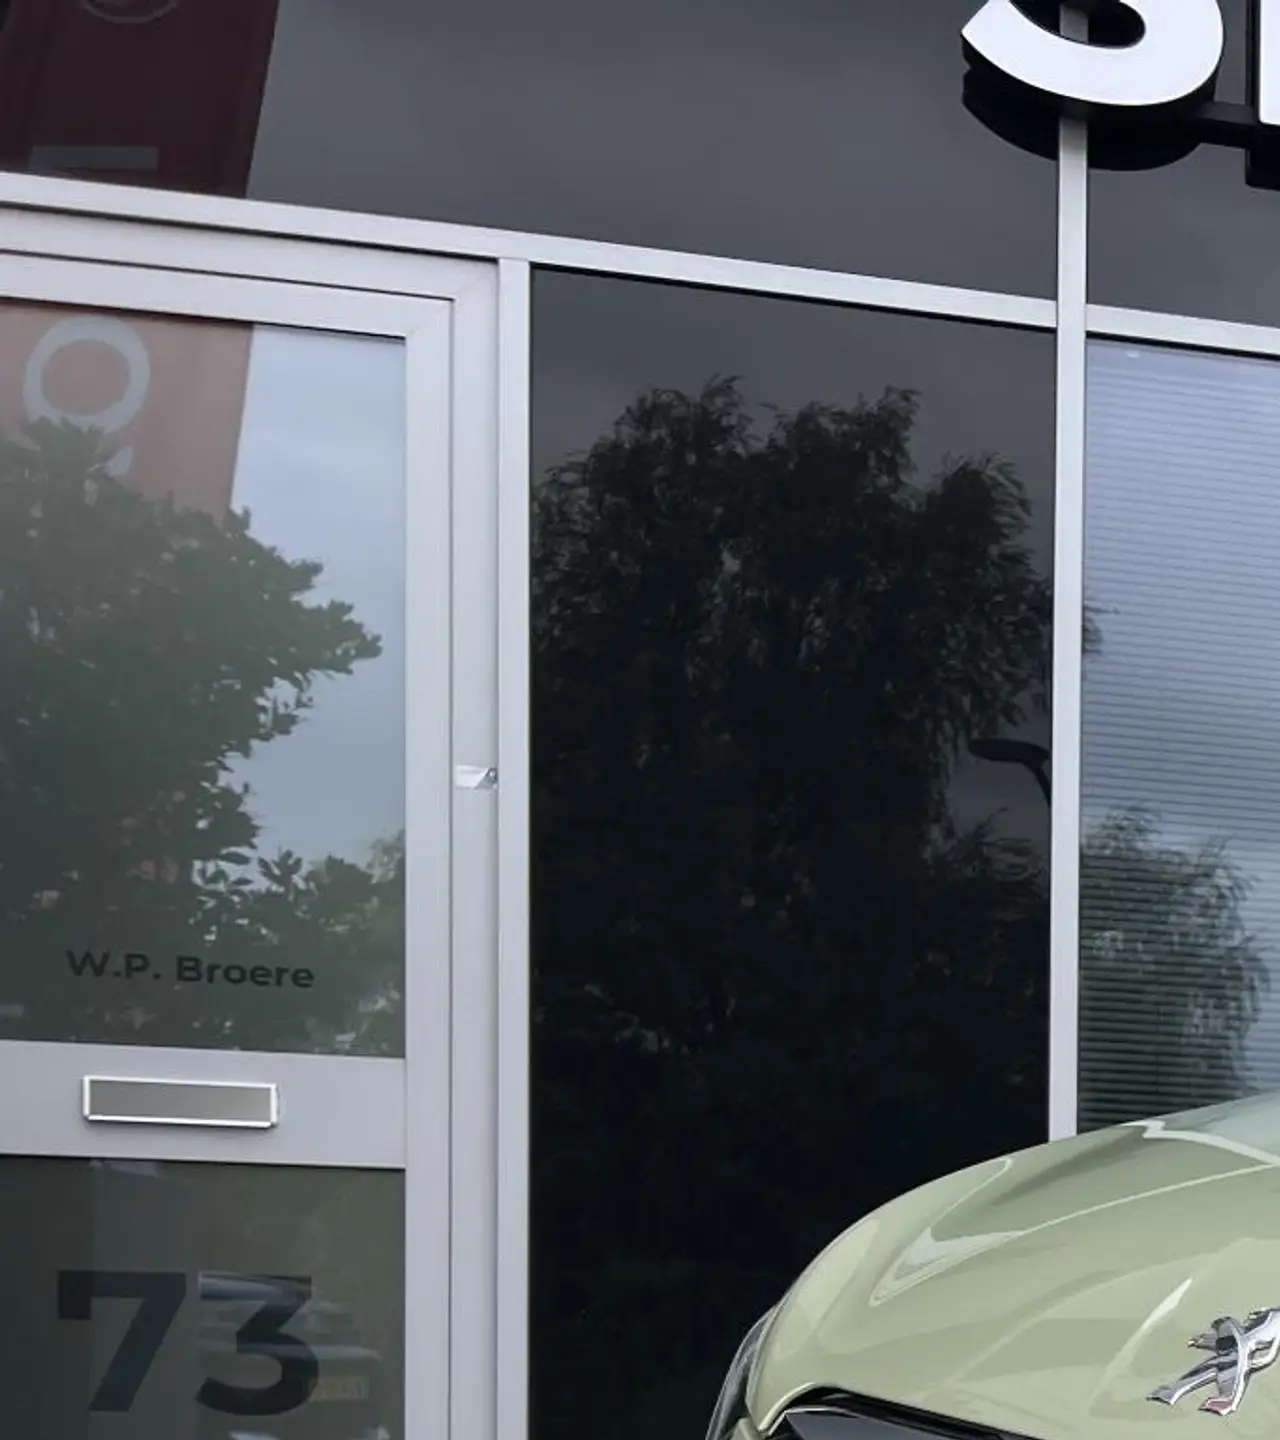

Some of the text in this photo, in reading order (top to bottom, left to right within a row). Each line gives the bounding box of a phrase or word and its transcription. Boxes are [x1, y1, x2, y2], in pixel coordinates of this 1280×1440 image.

[66, 949, 315, 988] W.P. Broere
[57, 1269, 320, 1416] 73
